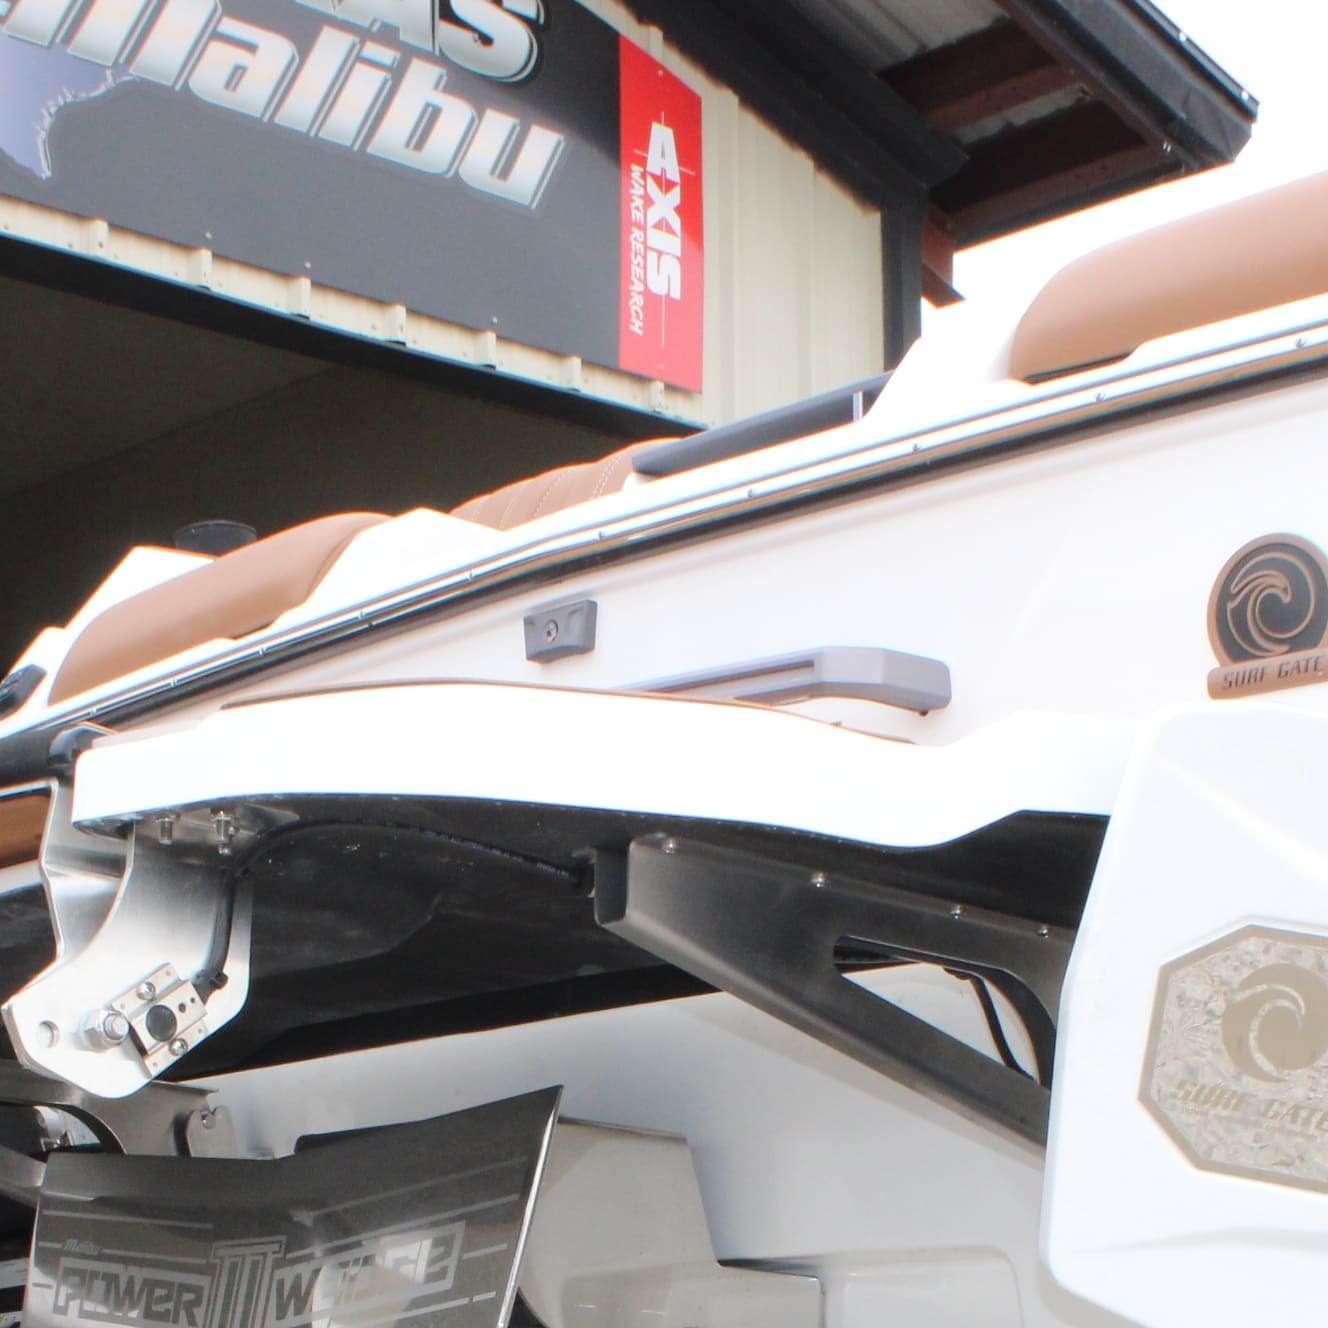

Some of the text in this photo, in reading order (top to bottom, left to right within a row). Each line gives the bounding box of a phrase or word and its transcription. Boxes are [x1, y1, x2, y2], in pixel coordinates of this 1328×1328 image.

[629, 164, 645, 337] WAKE RESEARCH
[645, 120, 682, 301] AXIS
[1277, 655, 1325, 679] GATE
